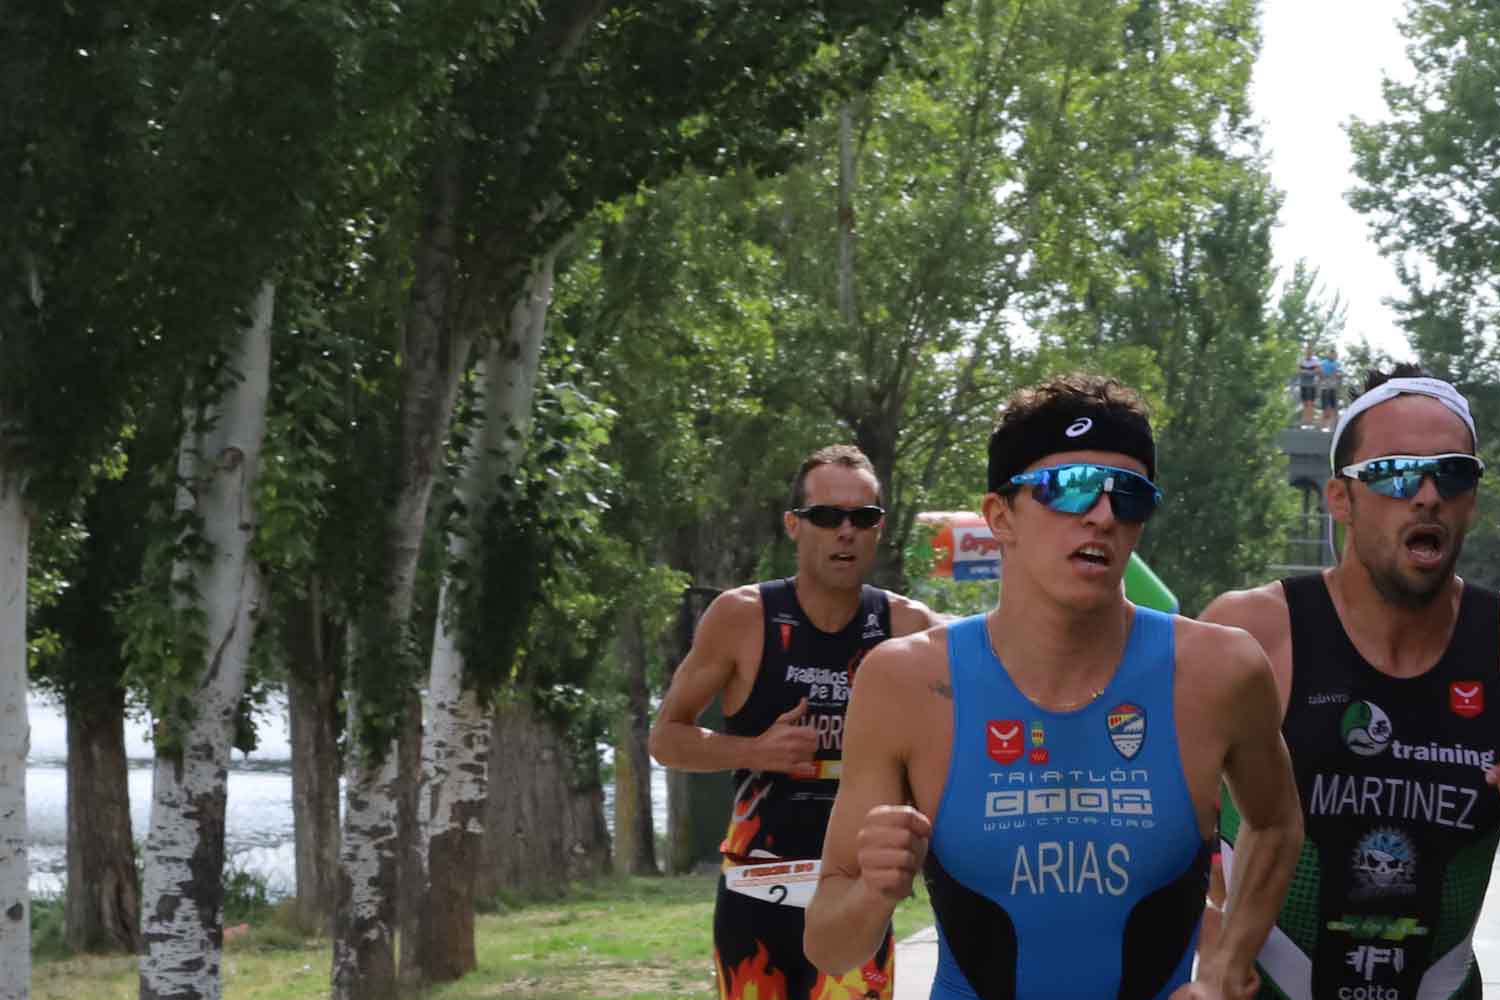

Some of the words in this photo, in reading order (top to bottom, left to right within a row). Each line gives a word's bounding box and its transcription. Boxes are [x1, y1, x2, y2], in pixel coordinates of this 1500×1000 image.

[988, 767, 1149, 785] TRIATLÓN
[1391, 737, 1496, 772] training
[1309, 772, 1479, 831] MARTINEZ
[1010, 840, 1131, 897] ARIAS
